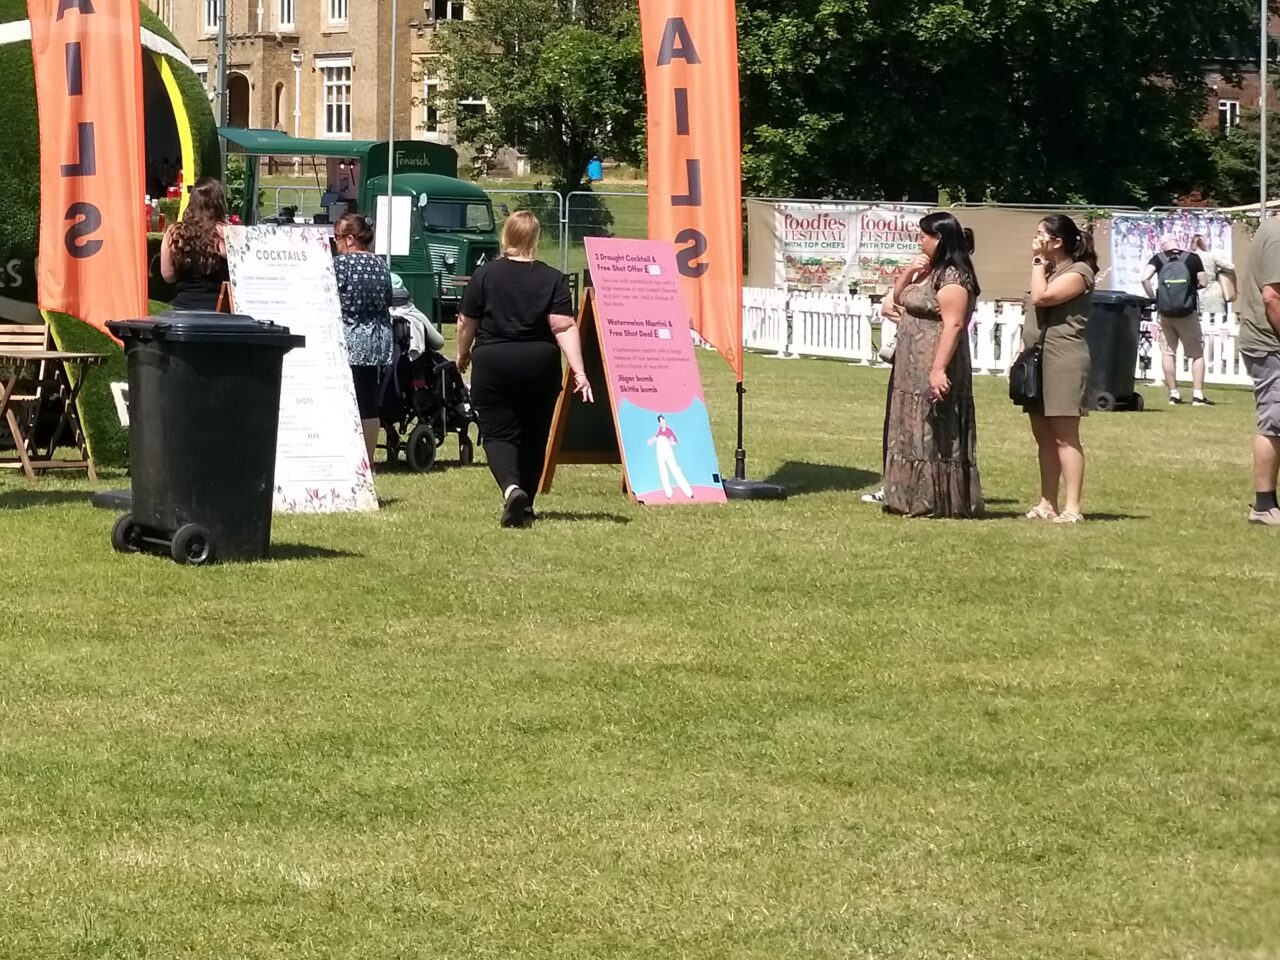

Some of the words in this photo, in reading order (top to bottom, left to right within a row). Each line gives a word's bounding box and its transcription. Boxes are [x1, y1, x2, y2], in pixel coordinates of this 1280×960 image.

[395, 150, 430, 168] Fenwick
[785, 213, 846, 230] foodies
[785, 231, 845, 241] FESTIVAL
[256, 250, 308, 262] COCKTAILS
[600, 254, 624, 262] Draught
